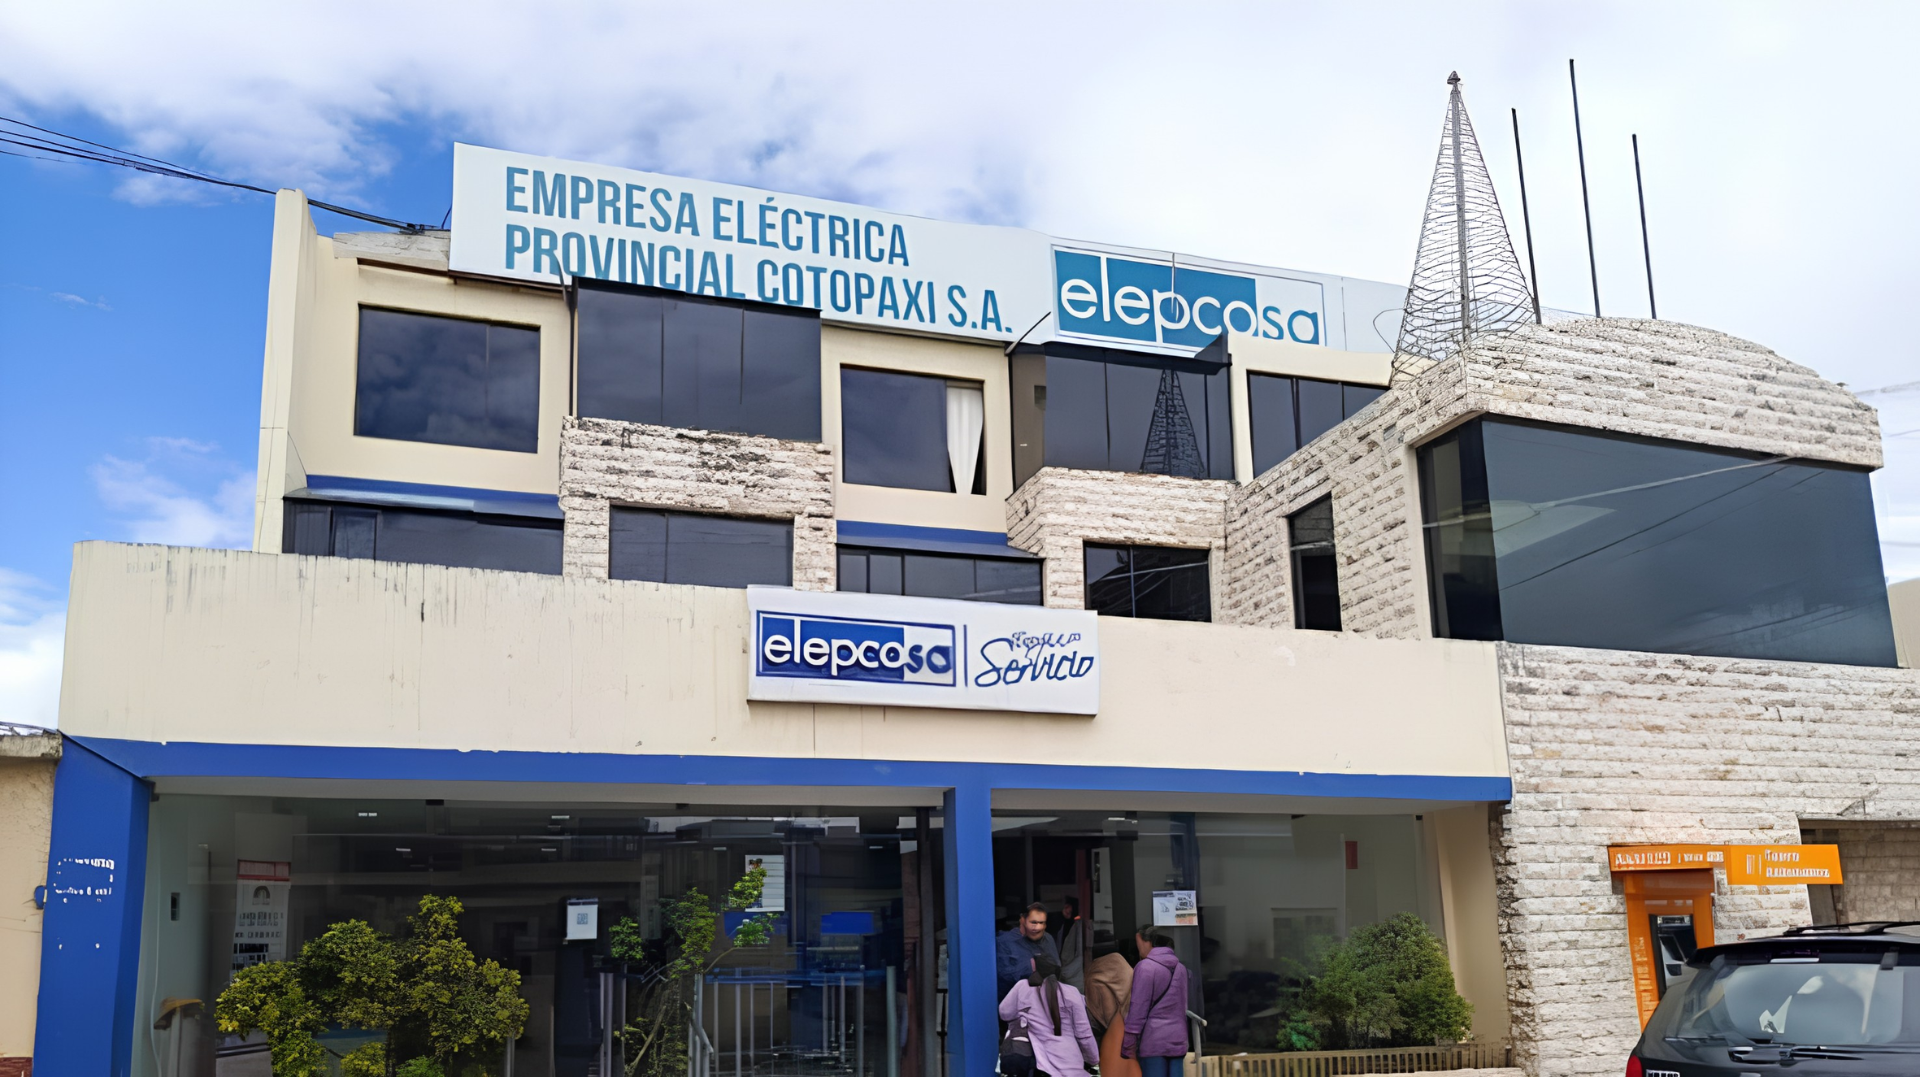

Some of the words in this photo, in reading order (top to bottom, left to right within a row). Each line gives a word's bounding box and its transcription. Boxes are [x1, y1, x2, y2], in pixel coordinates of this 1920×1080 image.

[506, 166, 700, 237] EMPRESA
[712, 196, 909, 267] ELÉCTRICA
[505, 223, 746, 298] PROVINCIAL
[757, 259, 936, 324] COTOPAXI
[947, 285, 1012, 333] S.A.
